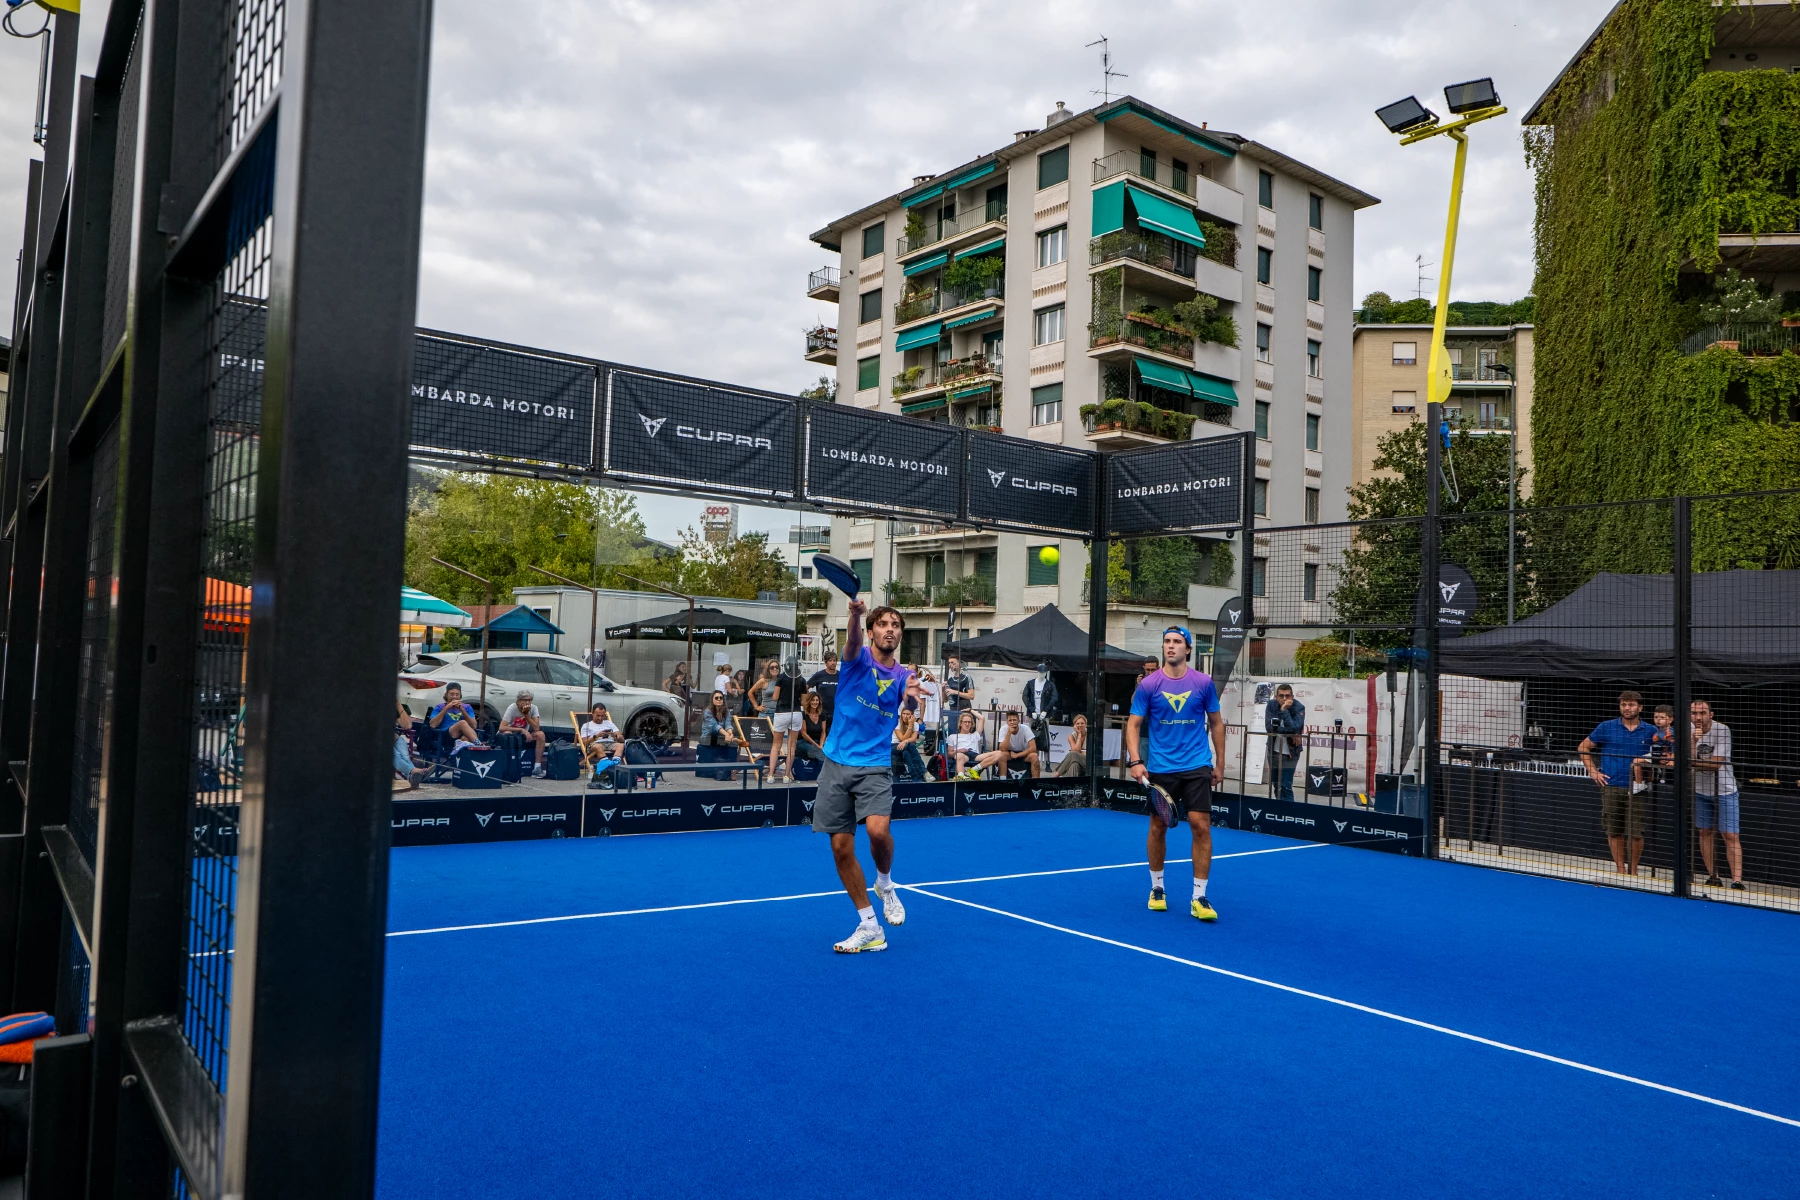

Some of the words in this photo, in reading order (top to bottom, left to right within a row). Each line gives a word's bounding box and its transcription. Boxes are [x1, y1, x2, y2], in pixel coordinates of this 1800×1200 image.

[411, 383, 495, 408] MBARDA
[502, 398, 575, 420] MOTORI
[676, 425, 772, 450] CUPRA
[822, 447, 895, 468] LOMBARDA
[900, 459, 948, 476] MOTORI
[1011, 477, 1078, 497] CUPRA
[1118, 483, 1179, 498] LOMBARDA
[1183, 476, 1231, 492] MOTORI
[978, 792, 1019, 801] CUPRA
[1044, 789, 1082, 797] CUPRA
[1116, 792, 1147, 801] CUPR
[900, 796, 945, 805] CUPRA
[621, 808, 682, 818] CUPRA
[720, 804, 775, 813] CUPRA
[391, 817, 450, 828] UPRA
[499, 813, 567, 823] CUPRA
[1265, 813, 1315, 827] CUPRA
[1352, 825, 1409, 840] CUPRA
